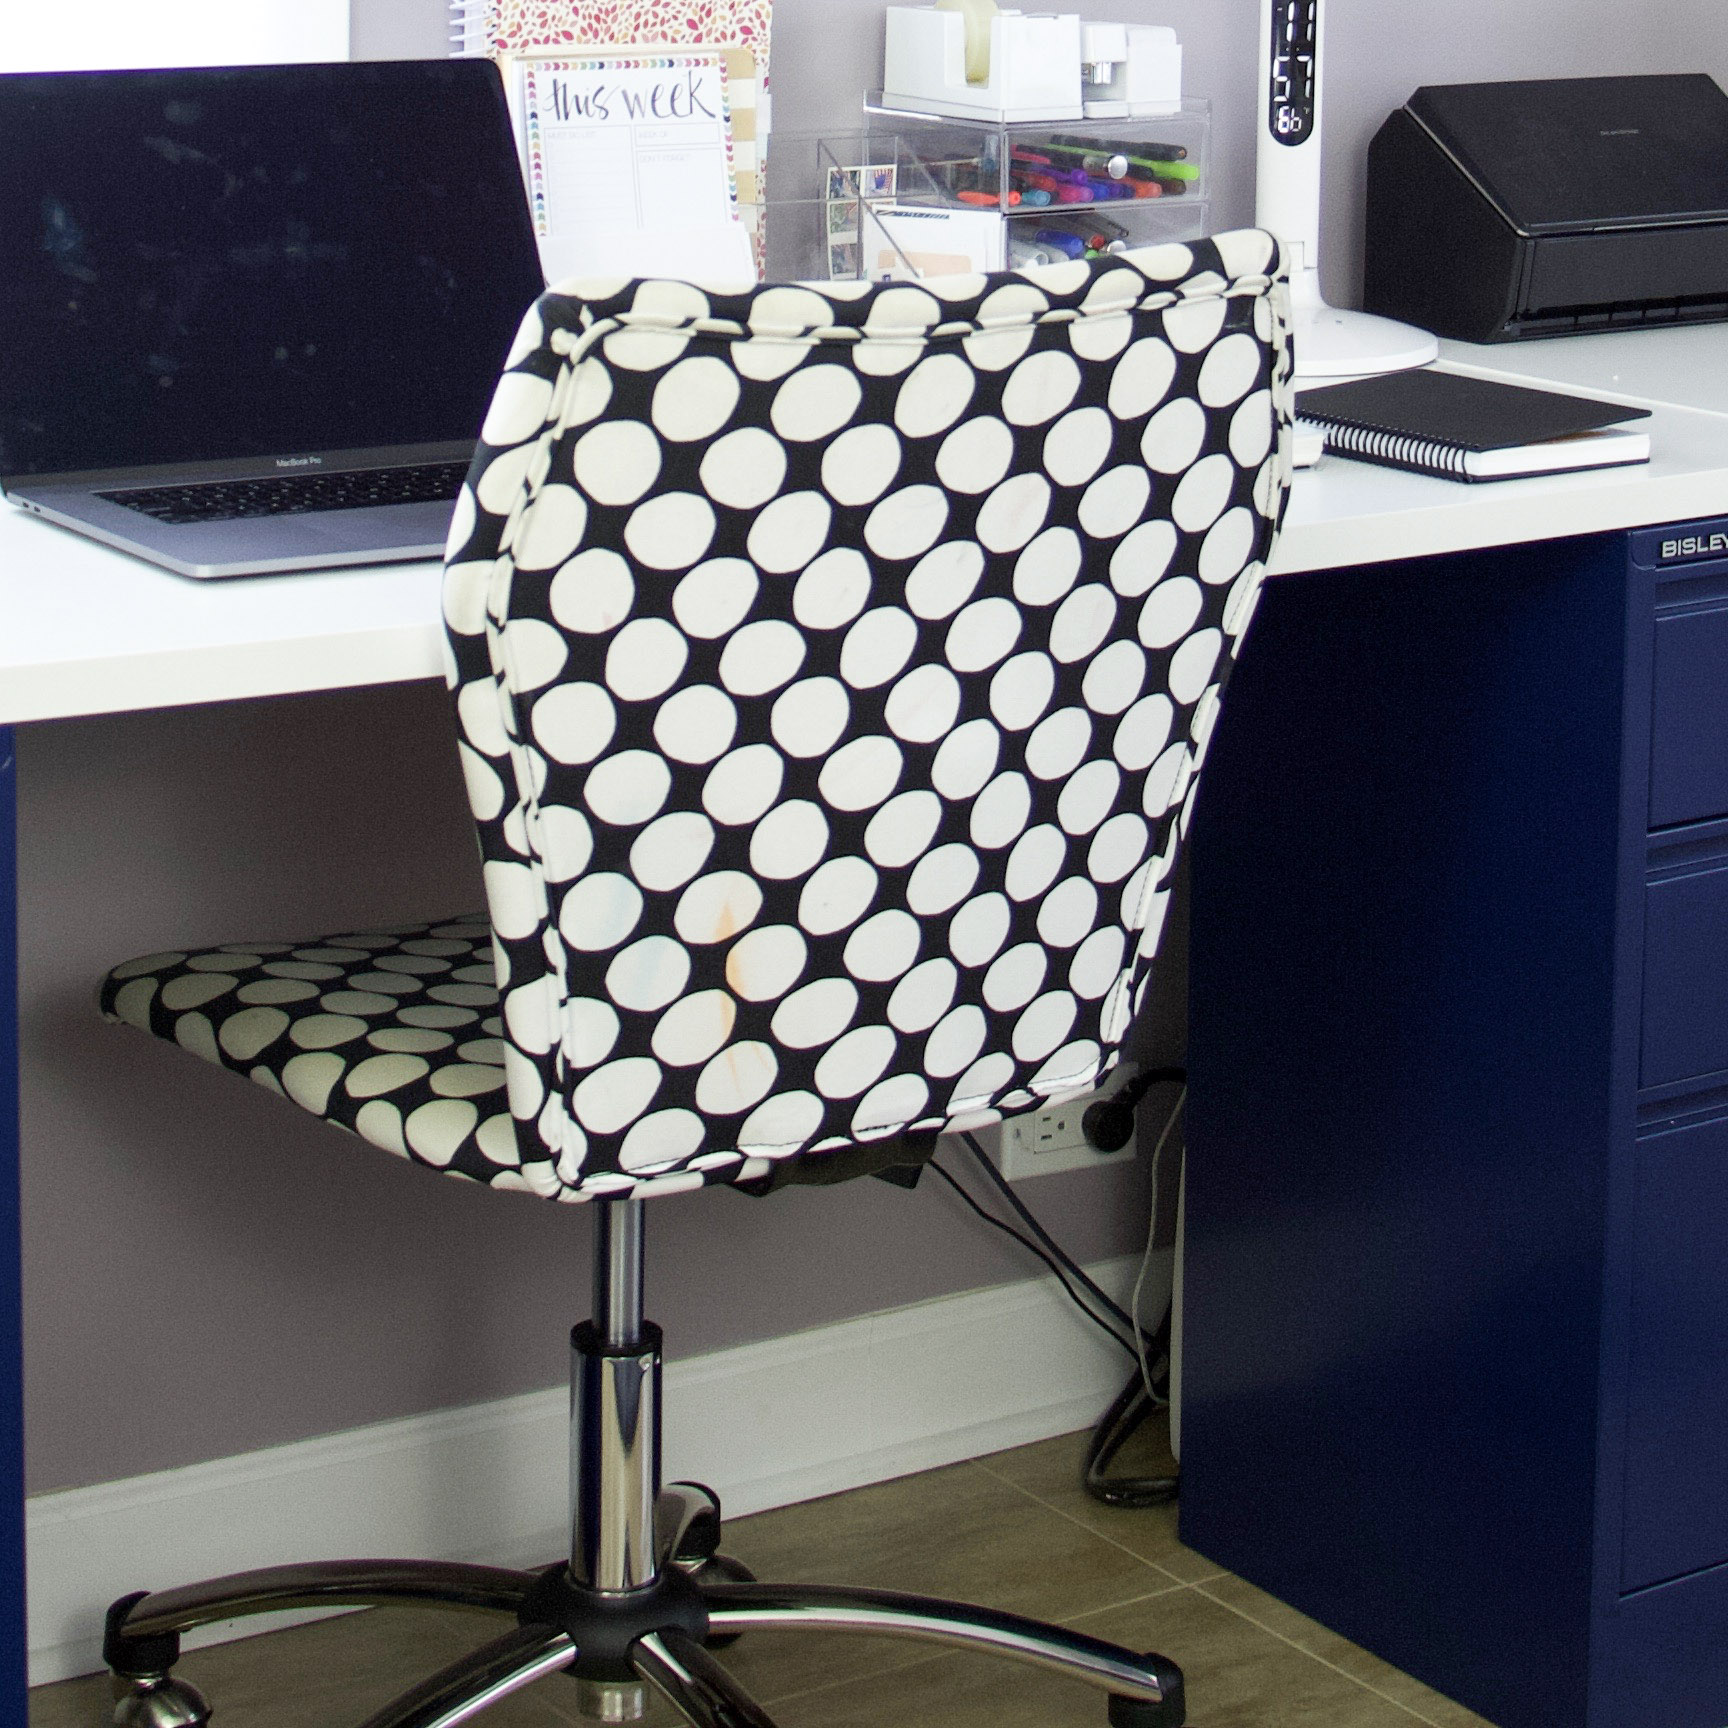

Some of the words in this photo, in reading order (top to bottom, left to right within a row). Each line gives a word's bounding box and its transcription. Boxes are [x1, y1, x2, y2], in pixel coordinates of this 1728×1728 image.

[543, 78, 612, 121] this
[622, 70, 717, 120] week
[276, 457, 308, 468] MacBook
[309, 456, 322, 464] Pro
